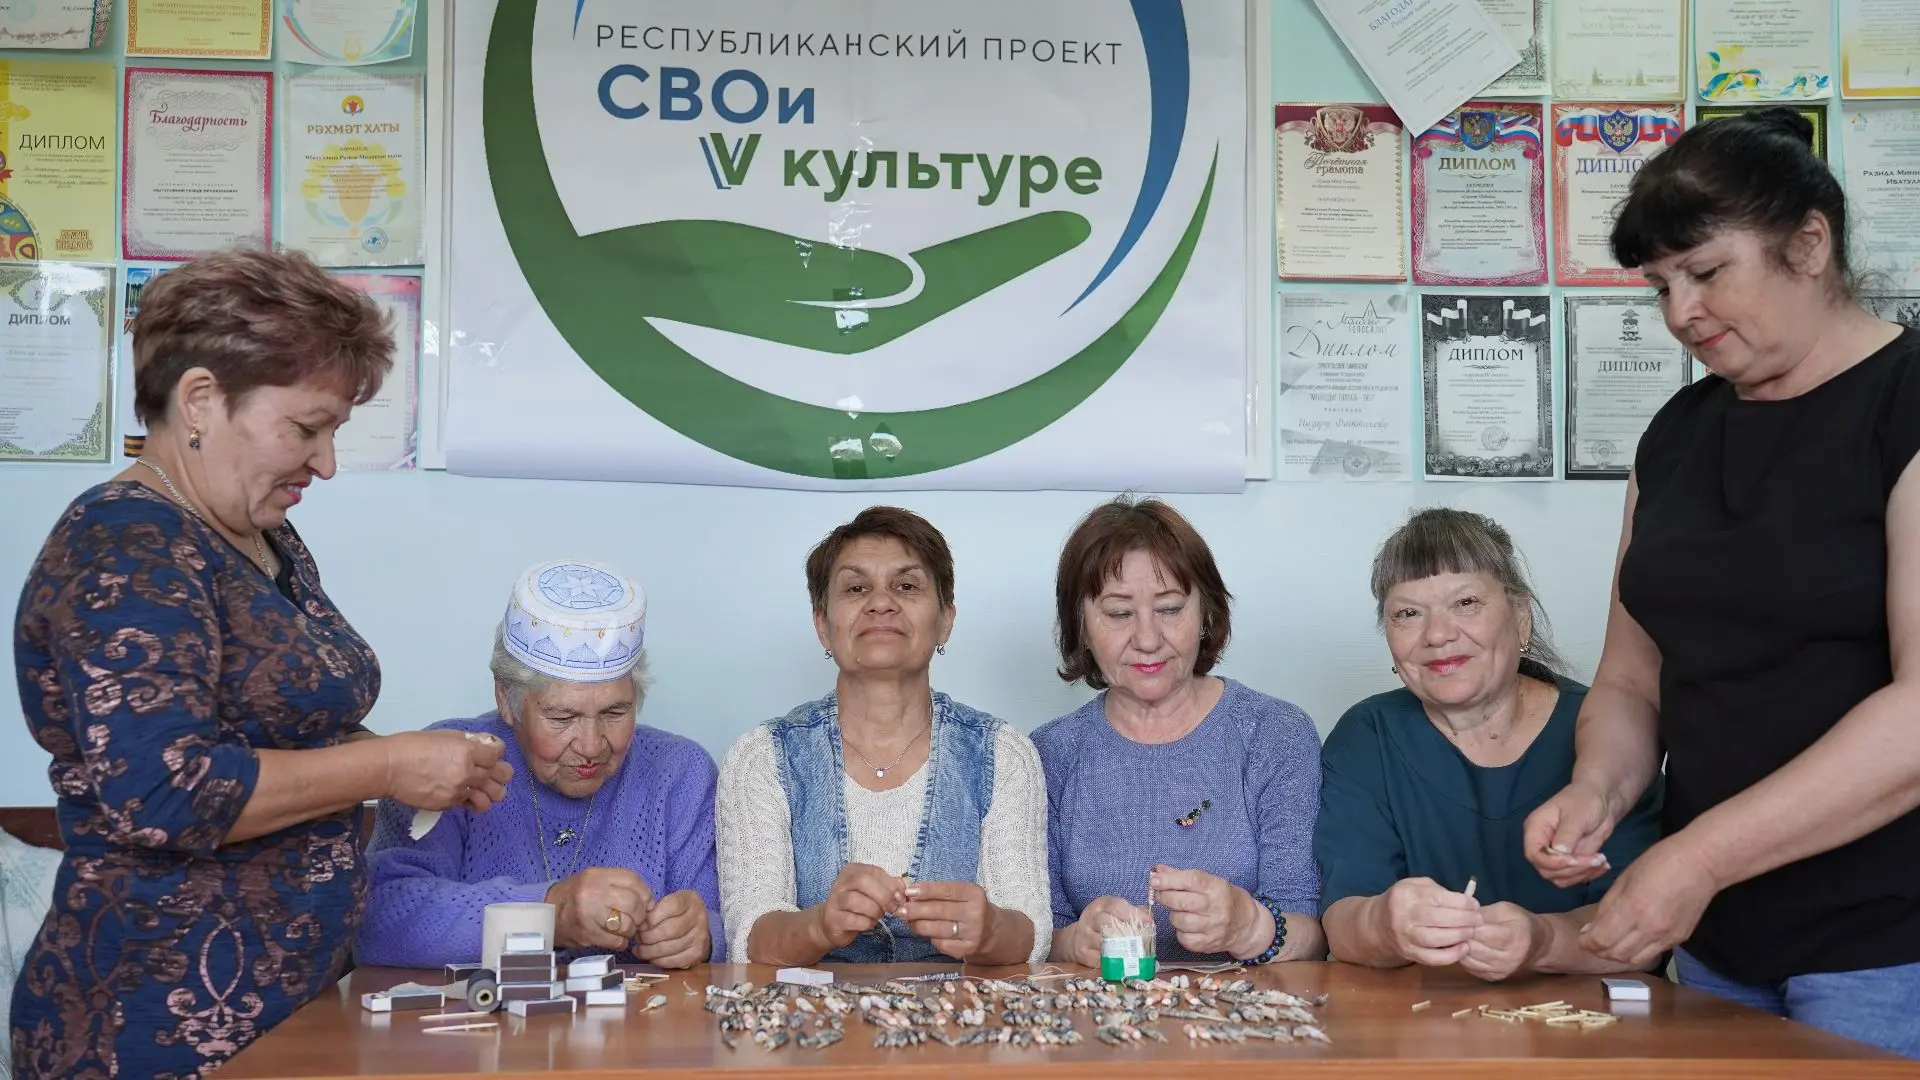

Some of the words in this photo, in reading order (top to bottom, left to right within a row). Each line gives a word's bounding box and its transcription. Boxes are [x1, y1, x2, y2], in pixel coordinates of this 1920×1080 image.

[596, 24, 968, 60] РЕСПУБЛИКАНСКИЙ
[984, 38, 1123, 65] ПРОЕКТ
[597, 64, 815, 124] СВОи
[149, 102, 248, 133] Благодарность
[307, 124, 362, 135] РӘХМӘТ
[364, 123, 400, 134] ХАТЫ
[19, 134, 105, 151] ДИПЛОМ
[1315, 165, 1364, 176] грамота
[1438, 157, 1516, 171] ДИПЛОМ
[1576, 157, 1645, 175] ДИПЛО
[783, 149, 1103, 208] культуре
[1286, 320, 1401, 358] Диплом
[1448, 348, 1523, 361] ДИПЛОМ
[1598, 360, 1662, 373] ДИПЛОМ
